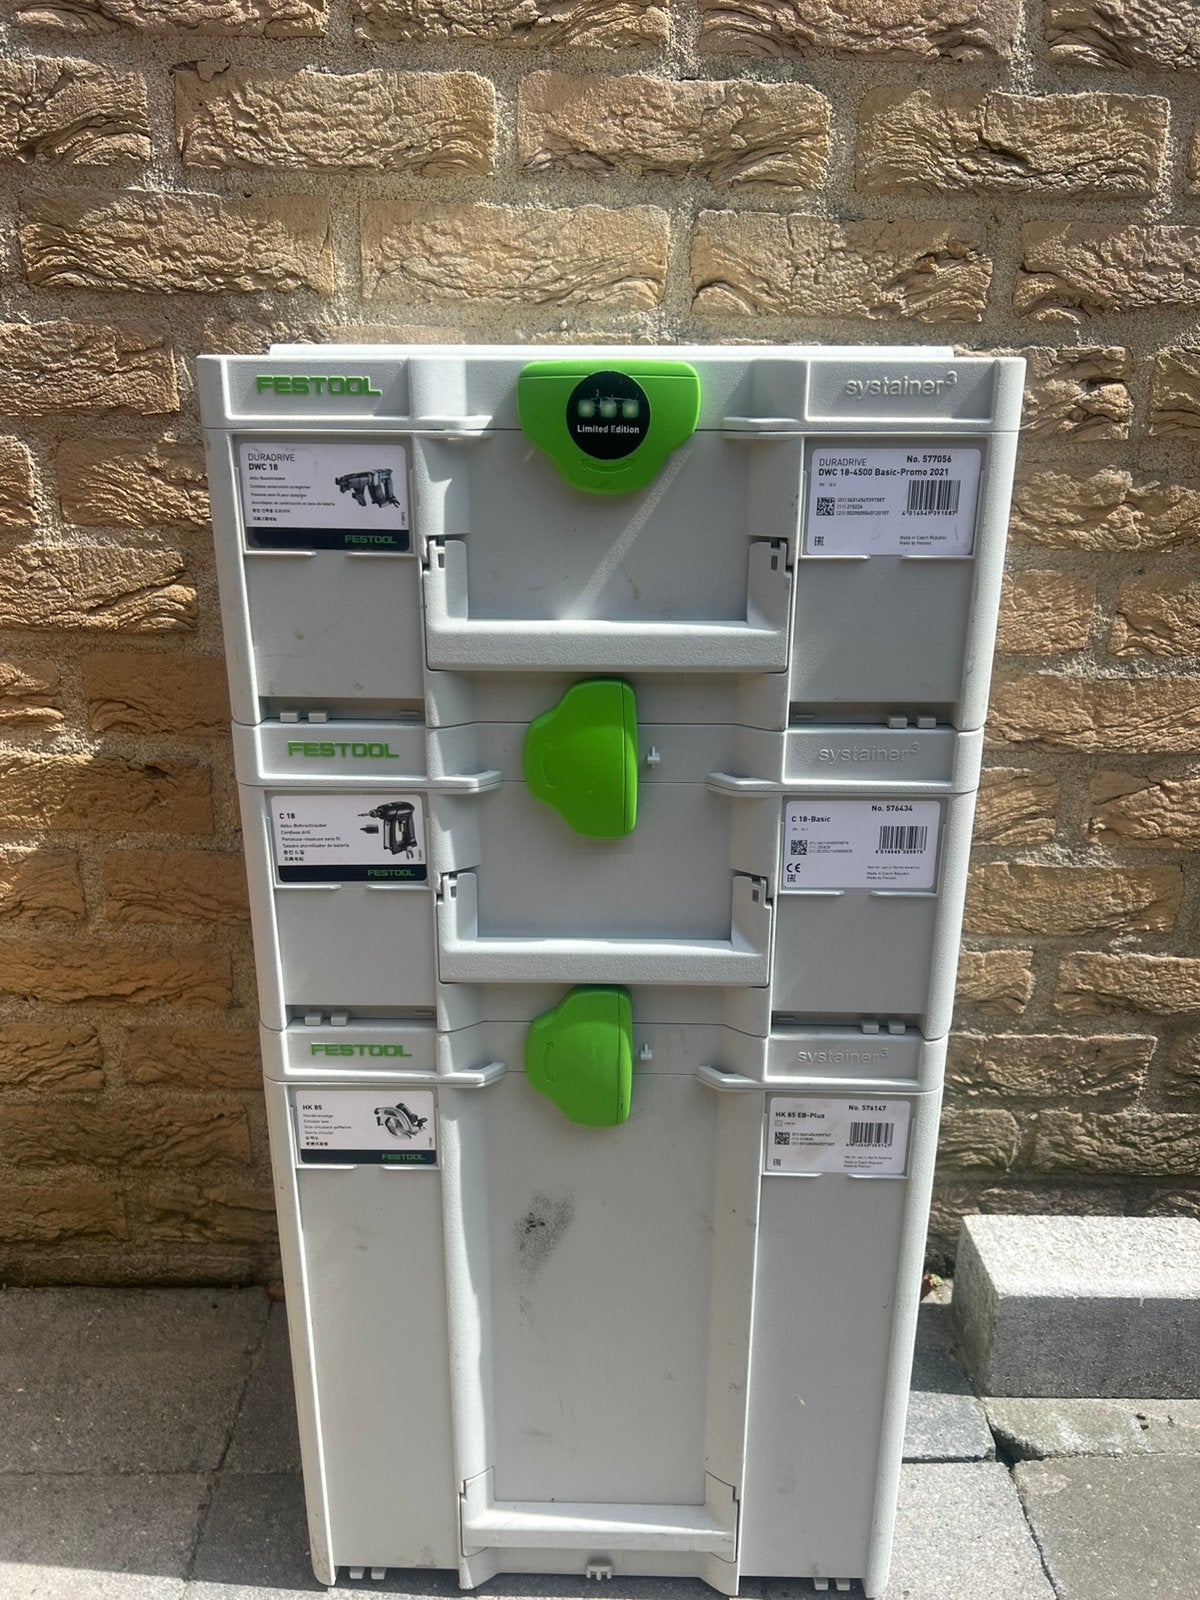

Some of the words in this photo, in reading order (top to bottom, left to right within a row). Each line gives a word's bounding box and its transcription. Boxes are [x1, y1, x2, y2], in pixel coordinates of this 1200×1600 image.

[255, 374, 382, 395] FESTOOL
[577, 424, 608, 434] Limited
[610, 425, 640, 434] Edition
[248, 453, 296, 462] DURADRIVE
[819, 458, 867, 466] DURADRIVE
[906, 455, 920, 463] No.
[922, 454, 952, 463] 577056
[818, 468, 838, 476] DWC
[840, 468, 873, 476] 18-4500
[874, 468, 928, 476] Basic-Promo
[930, 468, 949, 476] 2021
[344, 534, 398, 544] FESTOOL
[288, 740, 400, 759] FESTOOL
[367, 869, 416, 877] FESTOOL
[310, 1042, 413, 1057] FESTOOL
